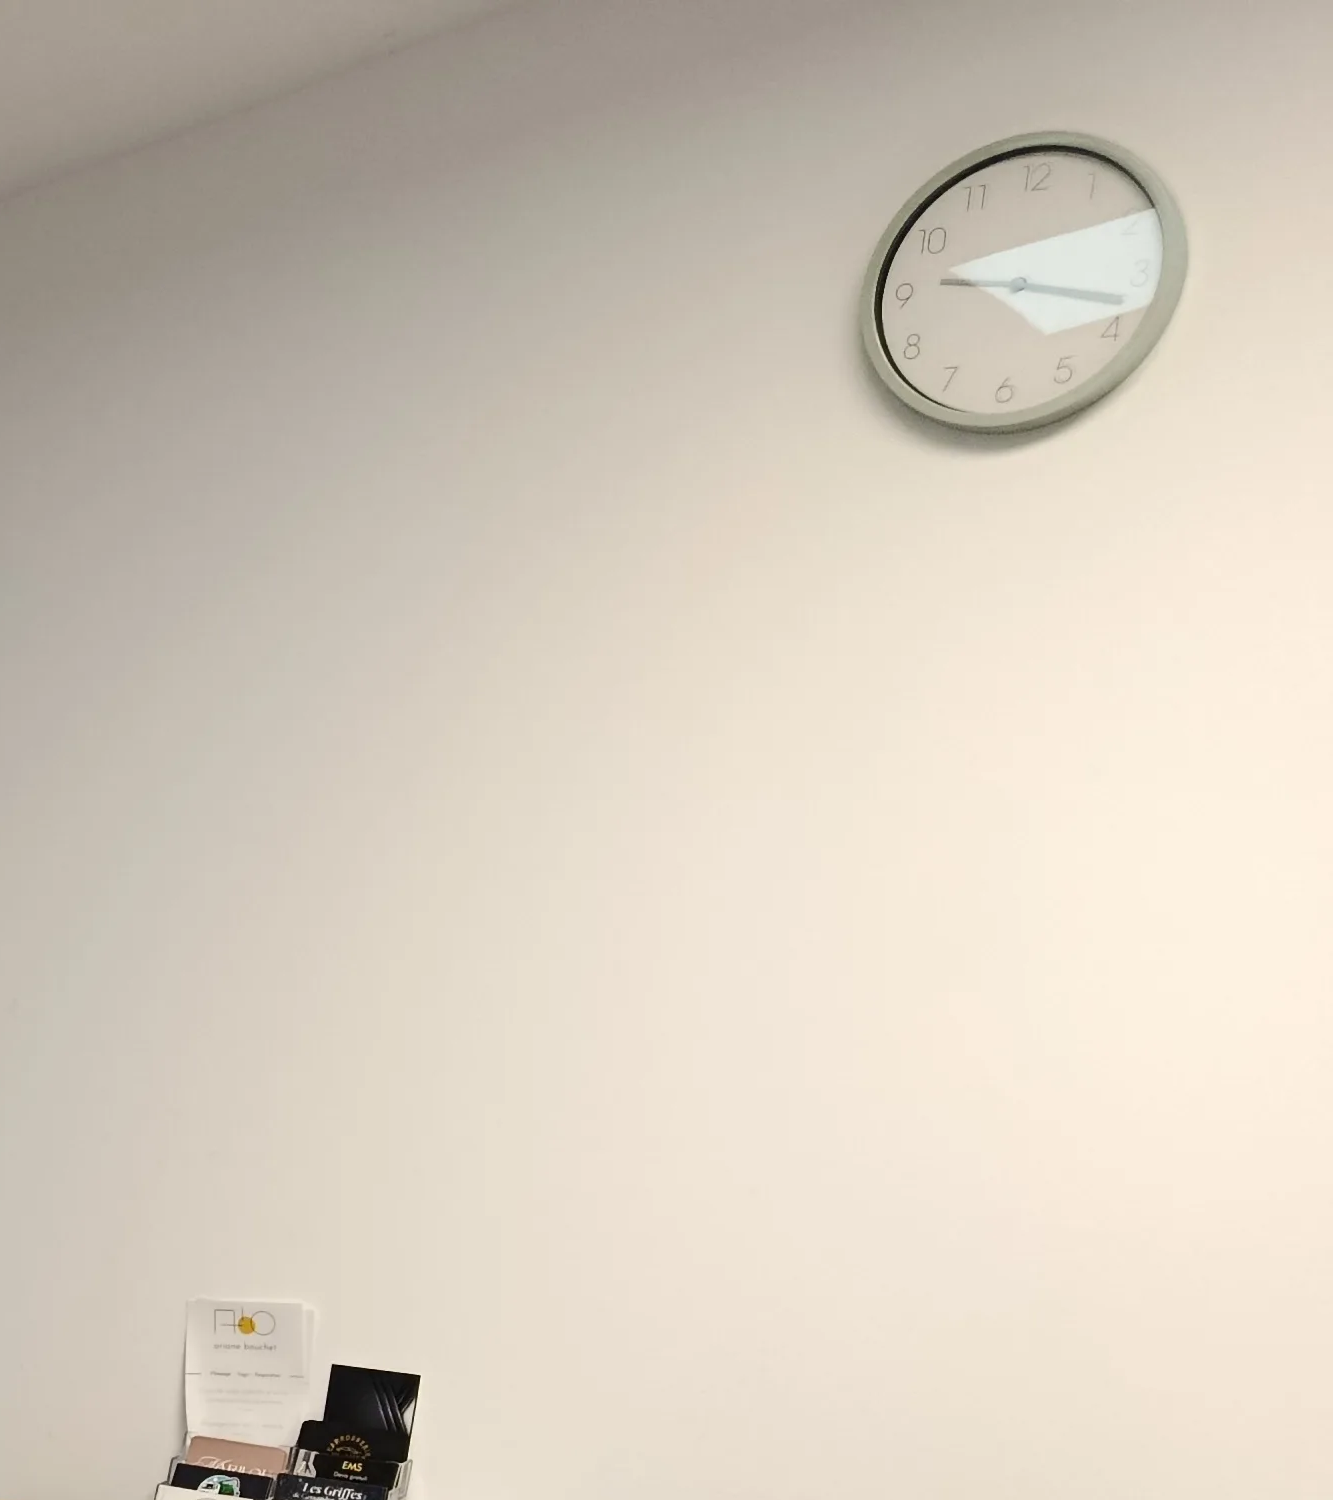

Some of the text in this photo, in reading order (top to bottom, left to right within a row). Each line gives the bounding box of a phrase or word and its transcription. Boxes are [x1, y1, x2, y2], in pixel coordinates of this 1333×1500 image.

[1022, 162, 1052, 192] 12
[963, 184, 988, 212] 11
[918, 227, 948, 255] 10
[1129, 259, 1151, 289] 3
[895, 283, 914, 309] 9
[1100, 315, 1121, 342] 4
[903, 333, 921, 360] 8
[942, 366, 958, 393] 7
[1053, 355, 1078, 384] 5
[994, 377, 1015, 404] 6
[341, 1461, 363, 1472] EMS
